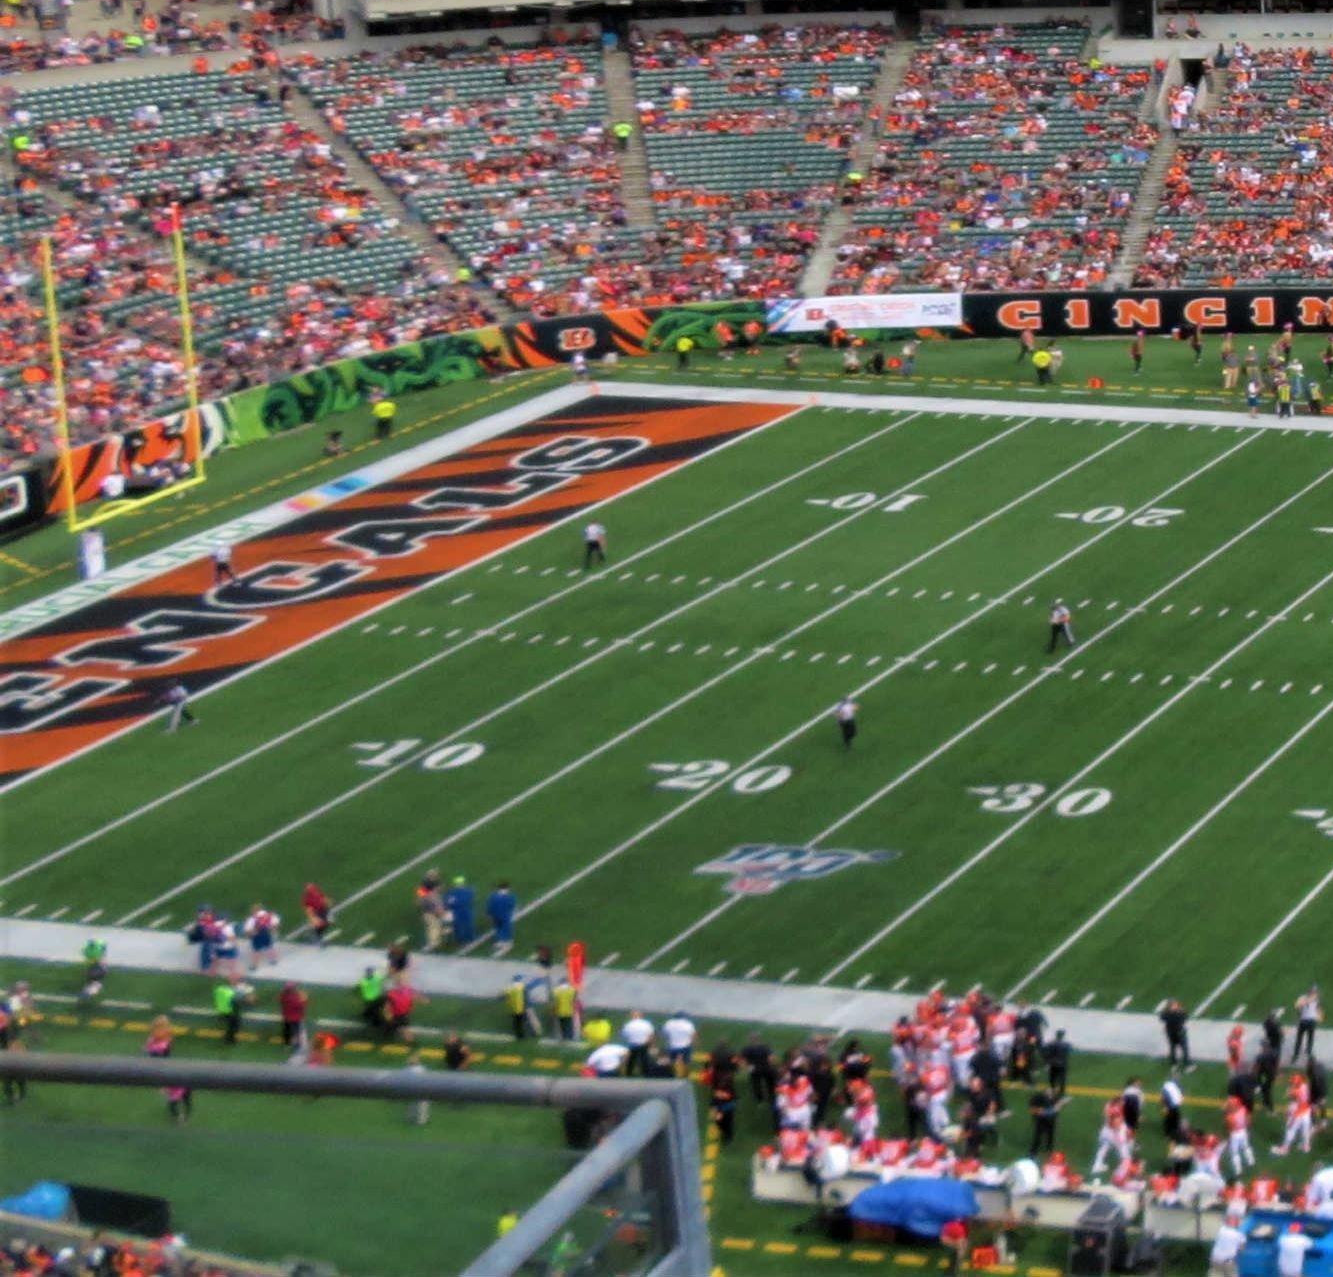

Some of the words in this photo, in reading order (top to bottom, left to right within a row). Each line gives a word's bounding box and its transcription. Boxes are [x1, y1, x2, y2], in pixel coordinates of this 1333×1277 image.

[829, 493, 928, 515] 10
[1078, 504, 1184, 528] 20
[358, 739, 486, 770] 10
[660, 759, 792, 795] 20
[983, 782, 1113, 818] 30
